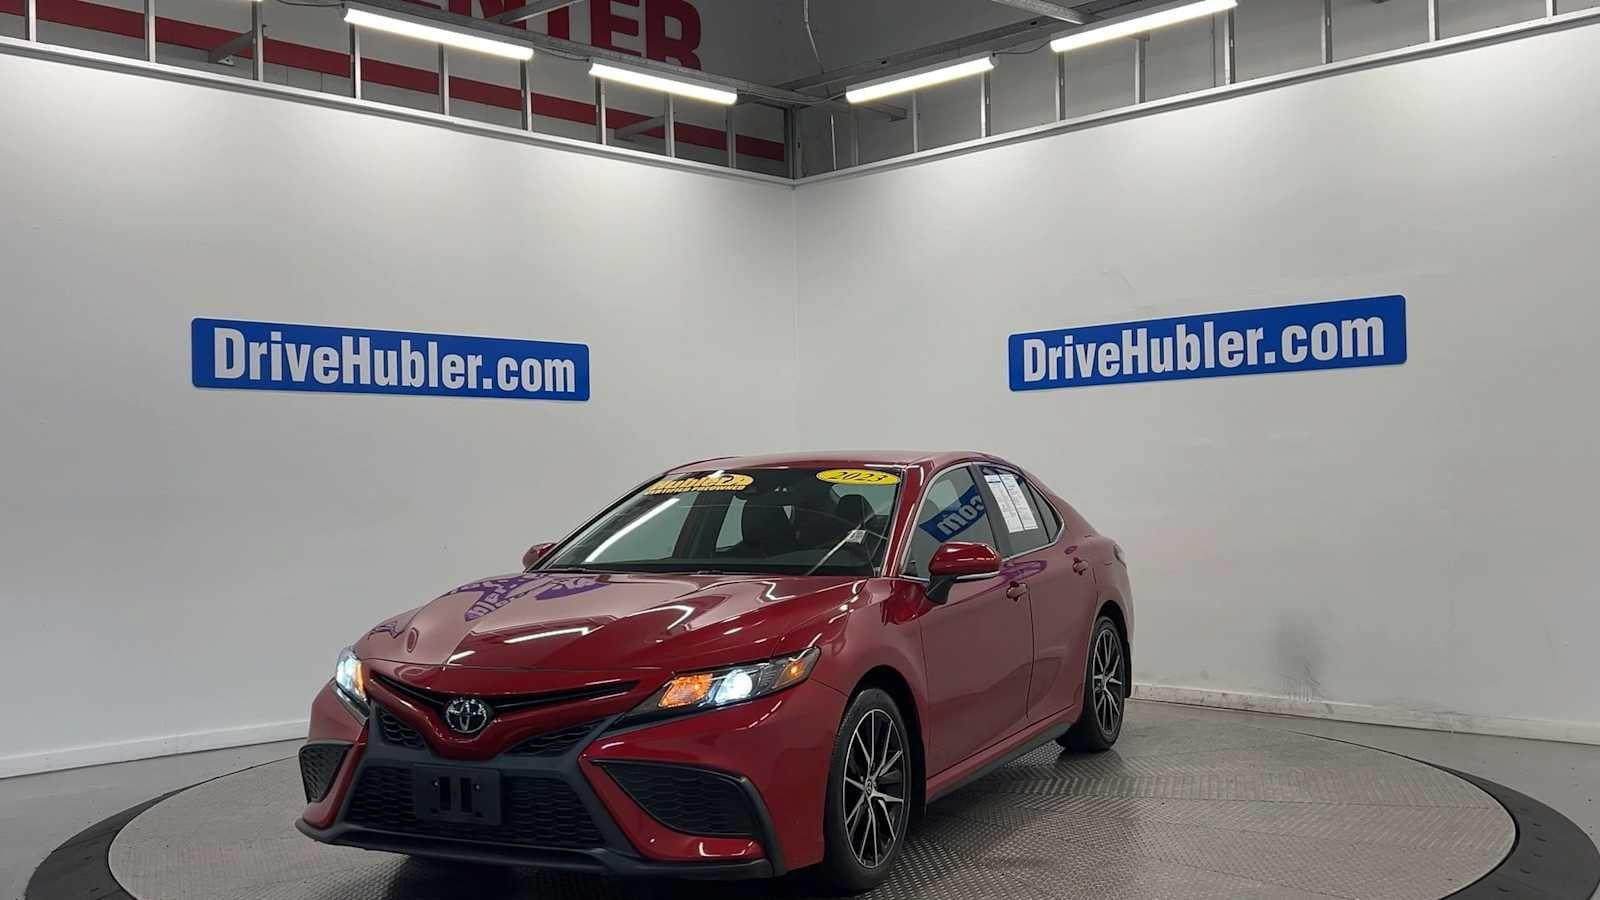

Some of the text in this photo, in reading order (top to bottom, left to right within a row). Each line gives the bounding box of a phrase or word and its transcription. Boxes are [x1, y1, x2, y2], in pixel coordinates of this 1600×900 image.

[213, 326, 576, 393] DriveHubler.com
[1023, 315, 1385, 383] DriveHubler.com
[827, 471, 889, 482] 2023
